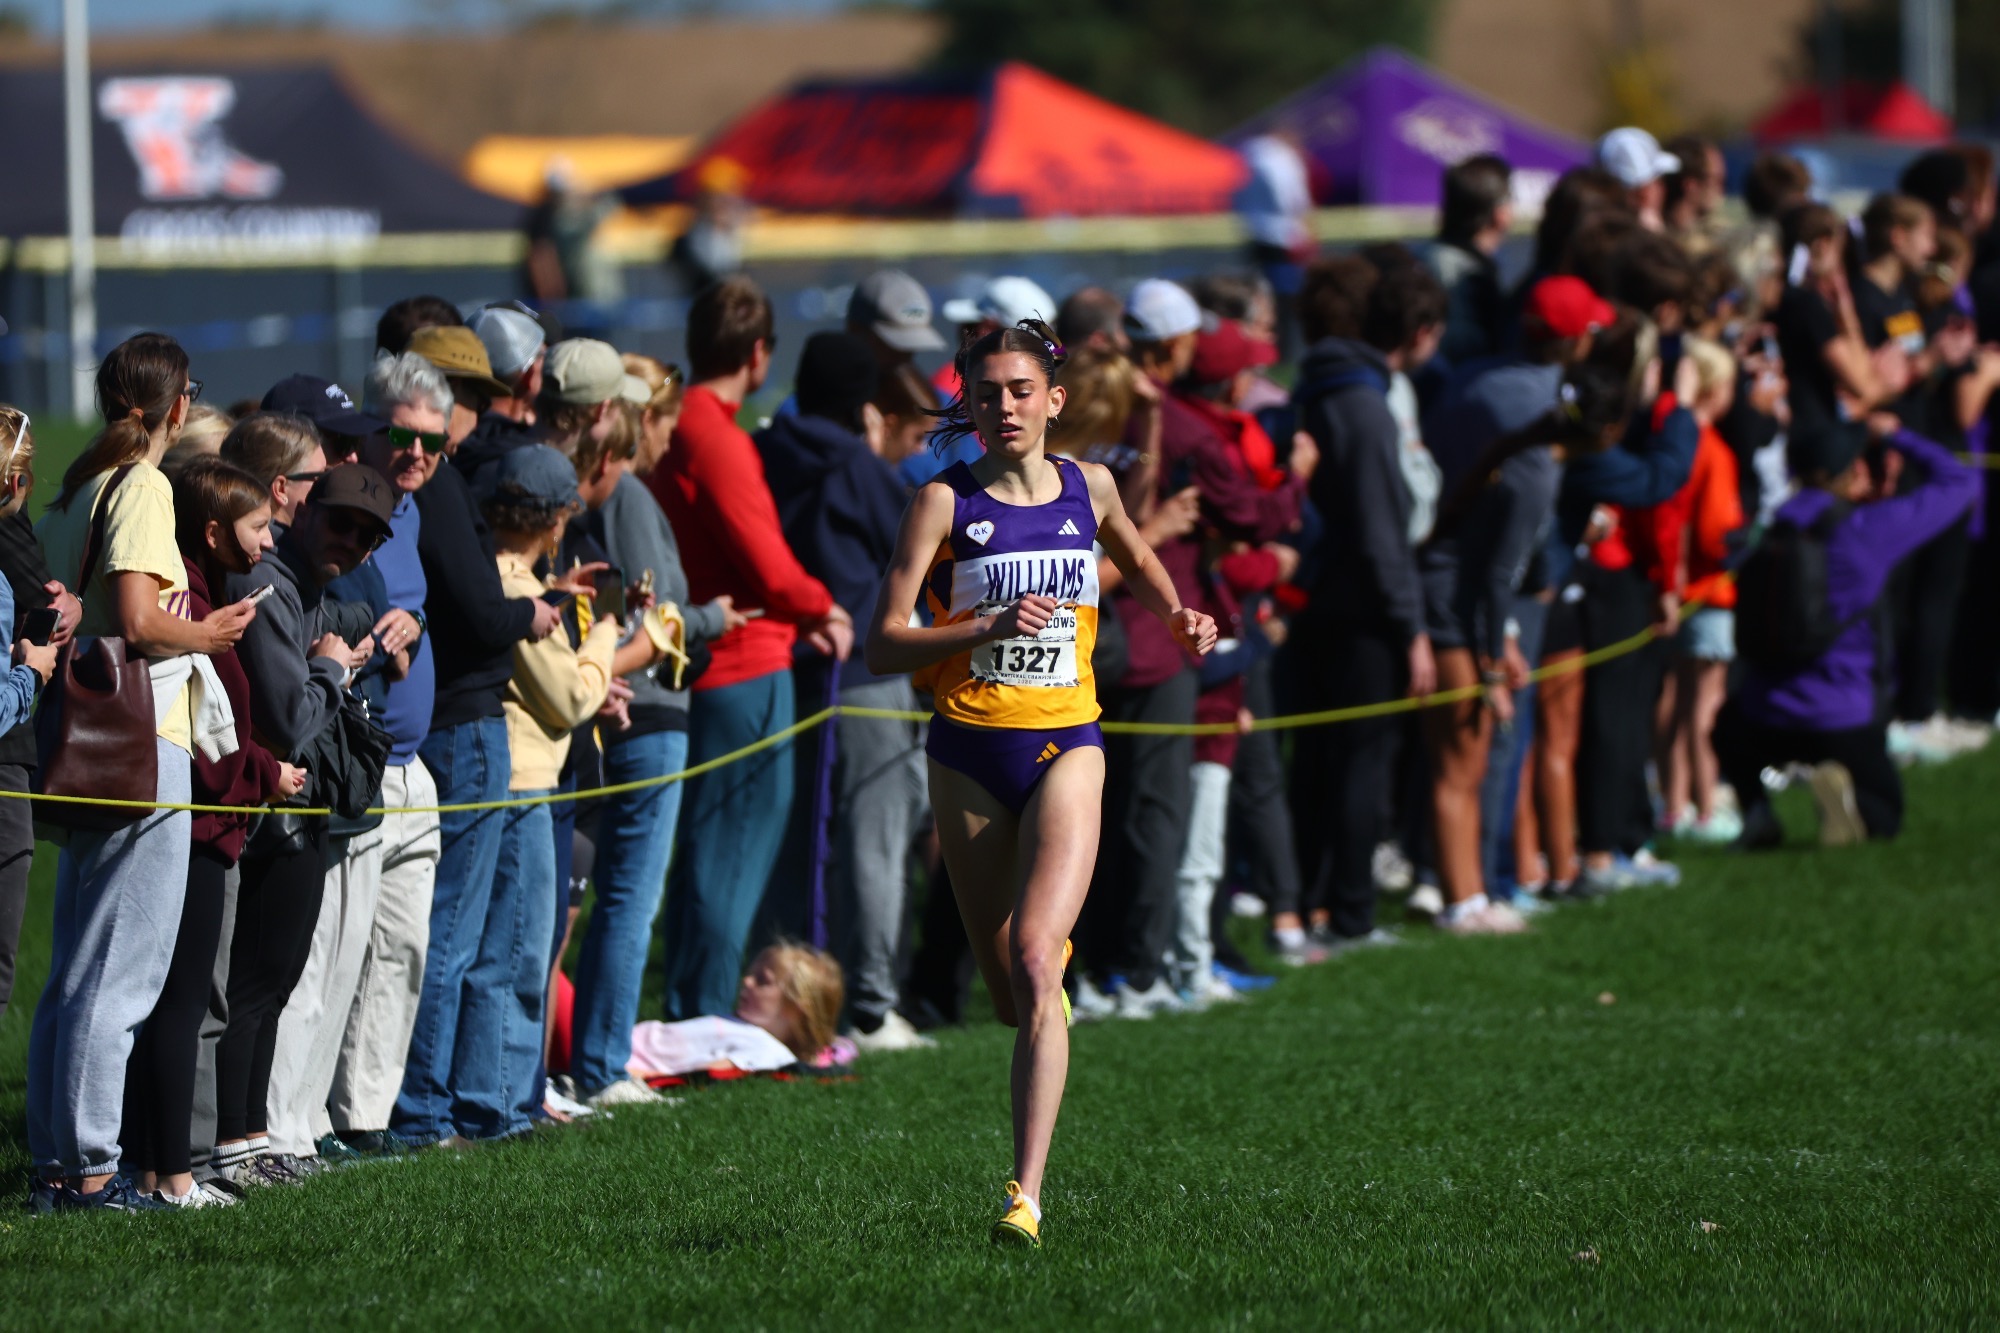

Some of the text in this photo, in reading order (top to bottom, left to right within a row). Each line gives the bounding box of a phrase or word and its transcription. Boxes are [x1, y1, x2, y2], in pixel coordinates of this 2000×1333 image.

[973, 526, 988, 536] AK
[985, 558, 1085, 601] WILLIAMS
[1045, 616, 1076, 628] COWS
[992, 644, 1061, 673] 1327
